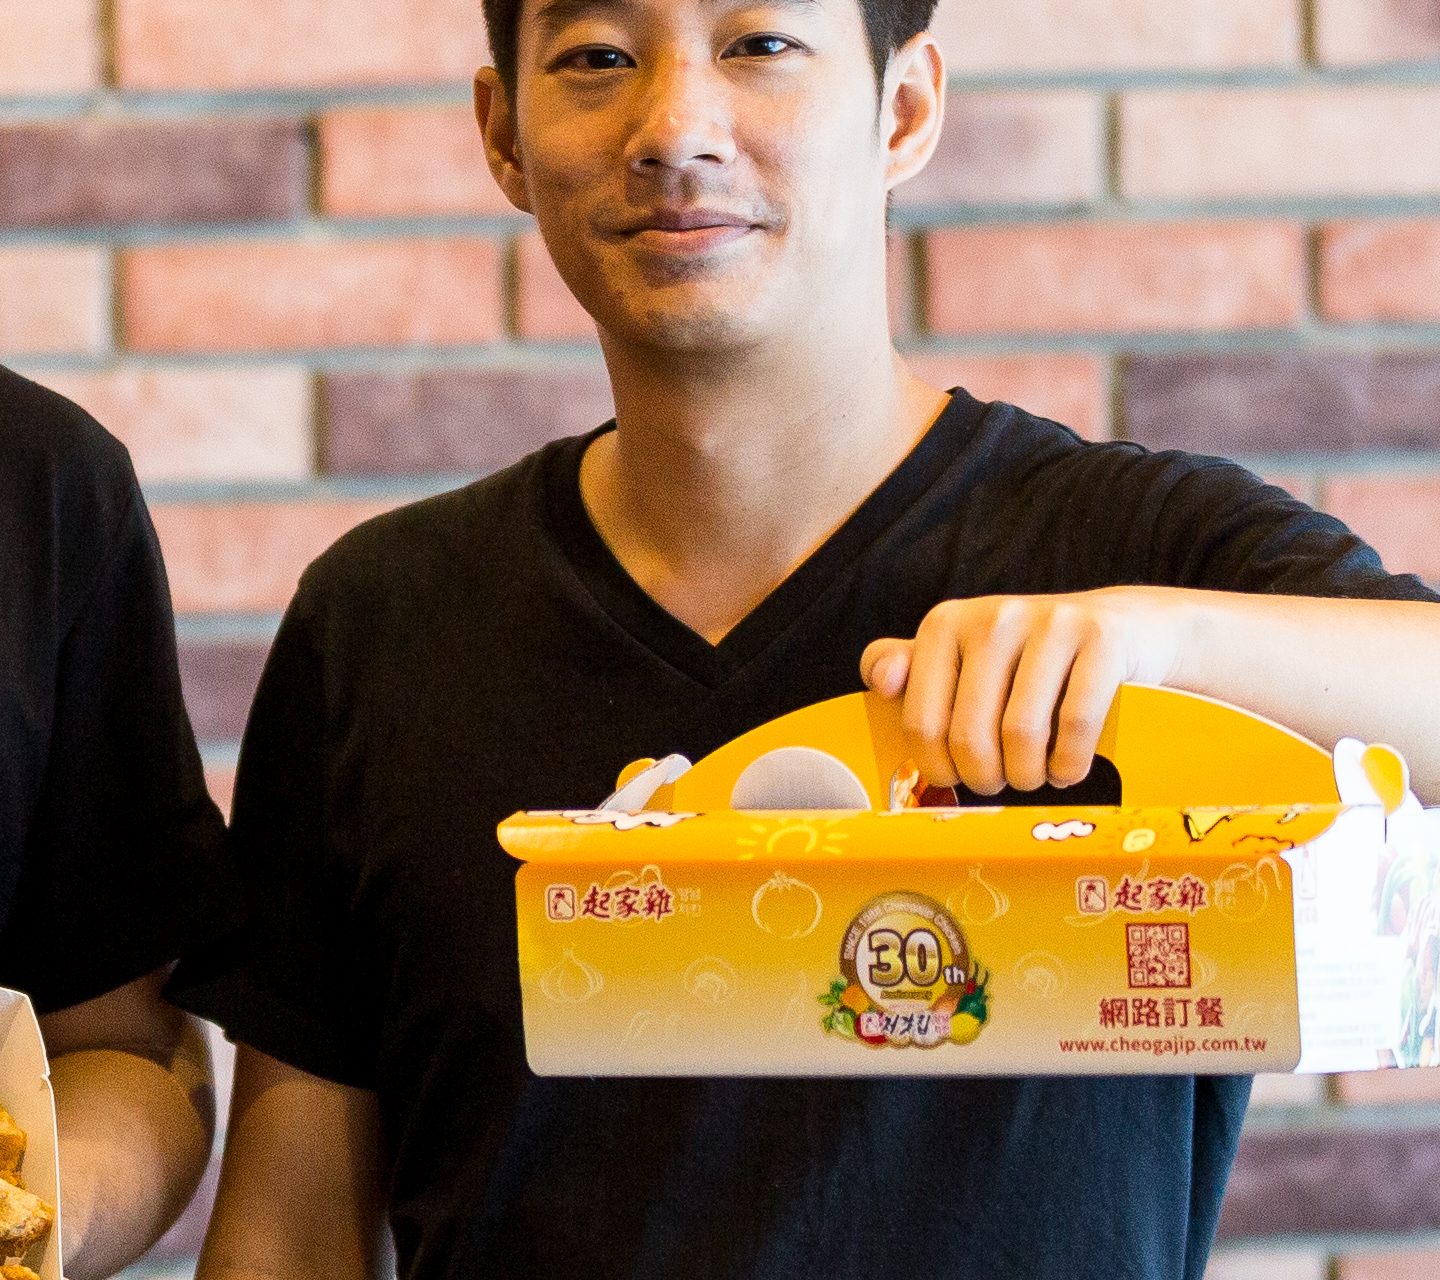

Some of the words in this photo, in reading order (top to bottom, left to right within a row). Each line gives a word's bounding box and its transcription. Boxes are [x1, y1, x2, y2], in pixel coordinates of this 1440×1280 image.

[582, 885, 673, 921] 起家雞
[1113, 876, 1206, 912] 起家雞
[1099, 996, 1224, 1029] 網路訂餐
[1058, 1035, 1269, 1056] www.cheogajip.com.tw
